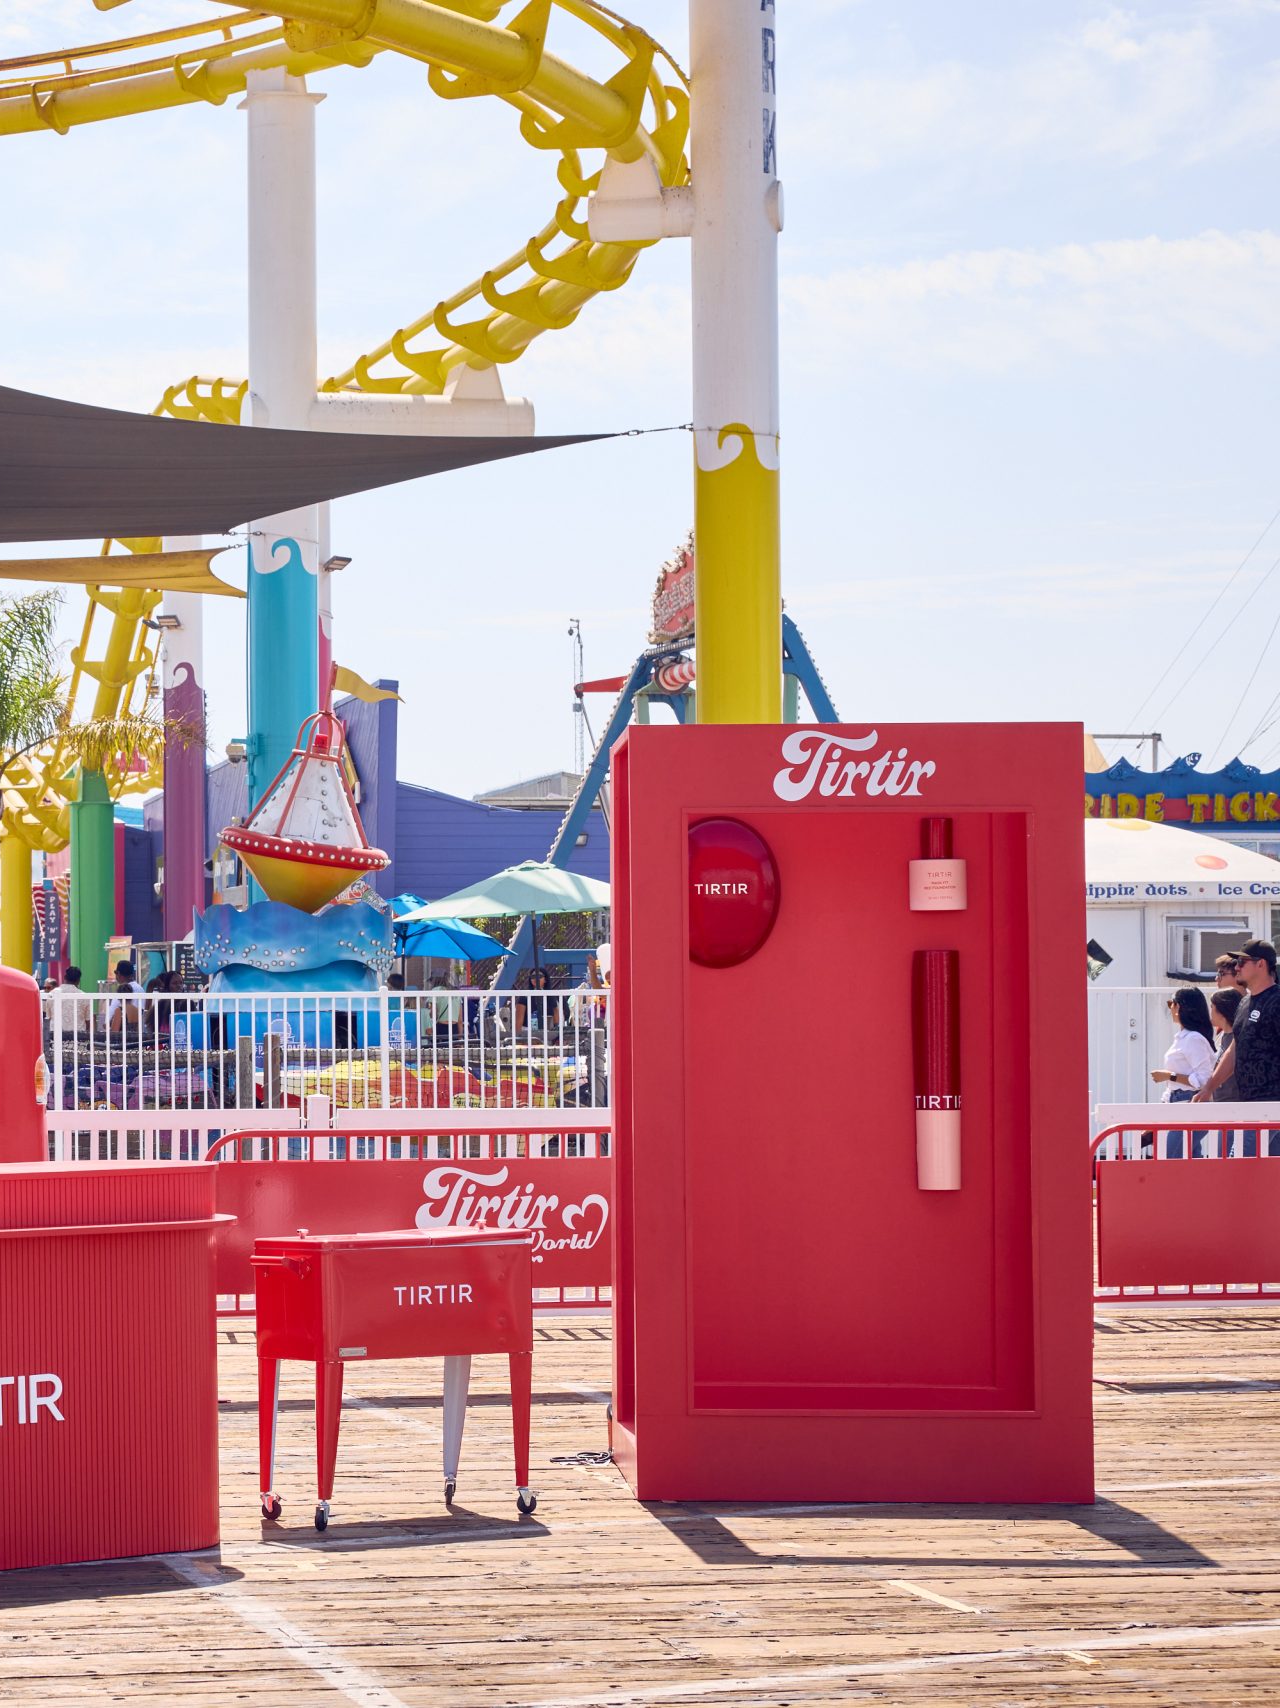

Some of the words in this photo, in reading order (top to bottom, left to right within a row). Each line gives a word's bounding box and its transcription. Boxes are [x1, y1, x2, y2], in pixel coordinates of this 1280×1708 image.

[773, 729, 936, 802] Tirtir
[1187, 791, 1280, 823] TICK
[694, 883, 748, 895] TIRTIR
[1085, 883, 1138, 898] ippin'
[1145, 884, 1188, 896] dots
[1218, 884, 1242, 895] Ice
[48, 938, 57, 957] WIN
[415, 1165, 559, 1230] Tirtir
[393, 1284, 473, 1306] TIRTIR
